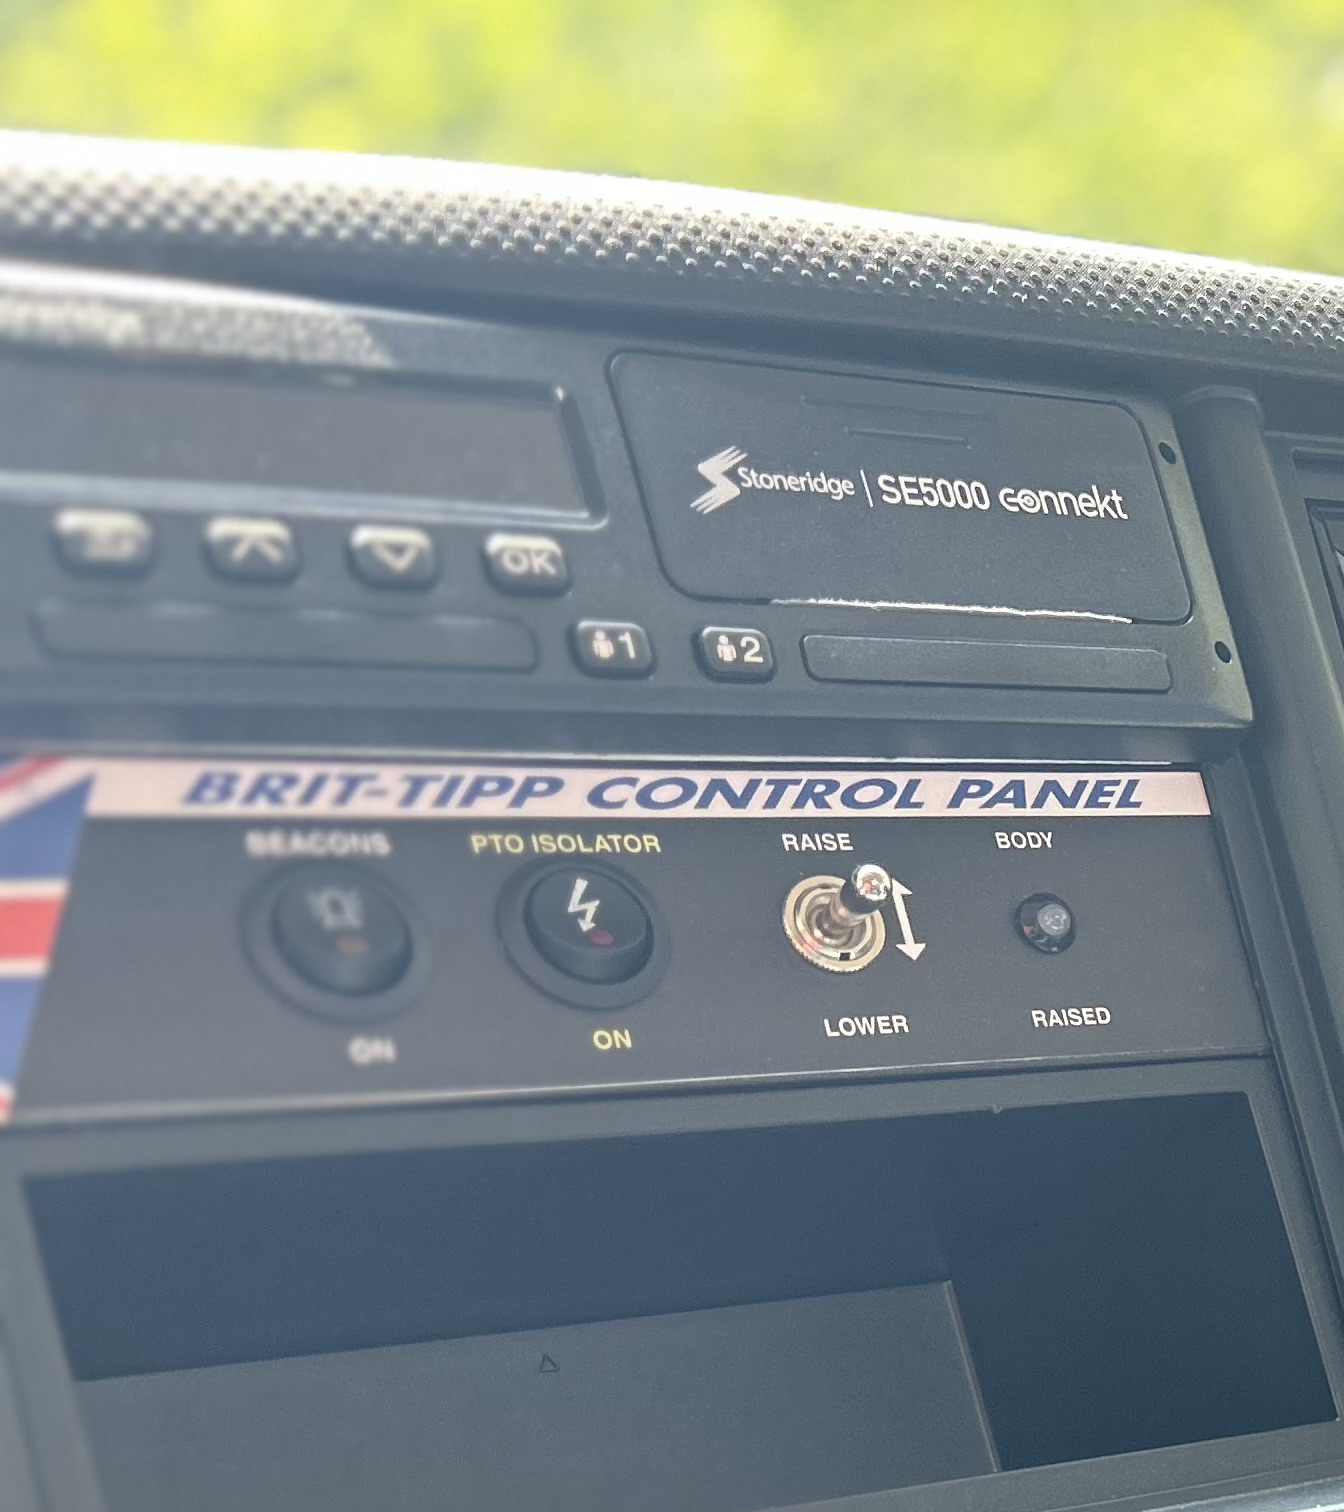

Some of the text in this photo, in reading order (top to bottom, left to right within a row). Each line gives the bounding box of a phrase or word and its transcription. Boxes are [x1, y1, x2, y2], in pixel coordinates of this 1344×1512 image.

[737, 466, 1129, 520] Stoneridge SE5000 connekt
[502, 548, 557, 575] OK
[618, 631, 637, 660] 1
[740, 636, 764, 663] 2
[181, 771, 1144, 811] BRIT-TIPP CONTROL PANEL
[245, 830, 393, 858] BEACONS
[469, 833, 662, 854] PTO ISOLATOR
[781, 832, 854, 853] RAISE
[994, 831, 1054, 850] BODY
[823, 1014, 910, 1038] LOWER
[1031, 1006, 1111, 1029] RAISED
[348, 1037, 396, 1066] ON
[592, 1029, 632, 1050] ON
